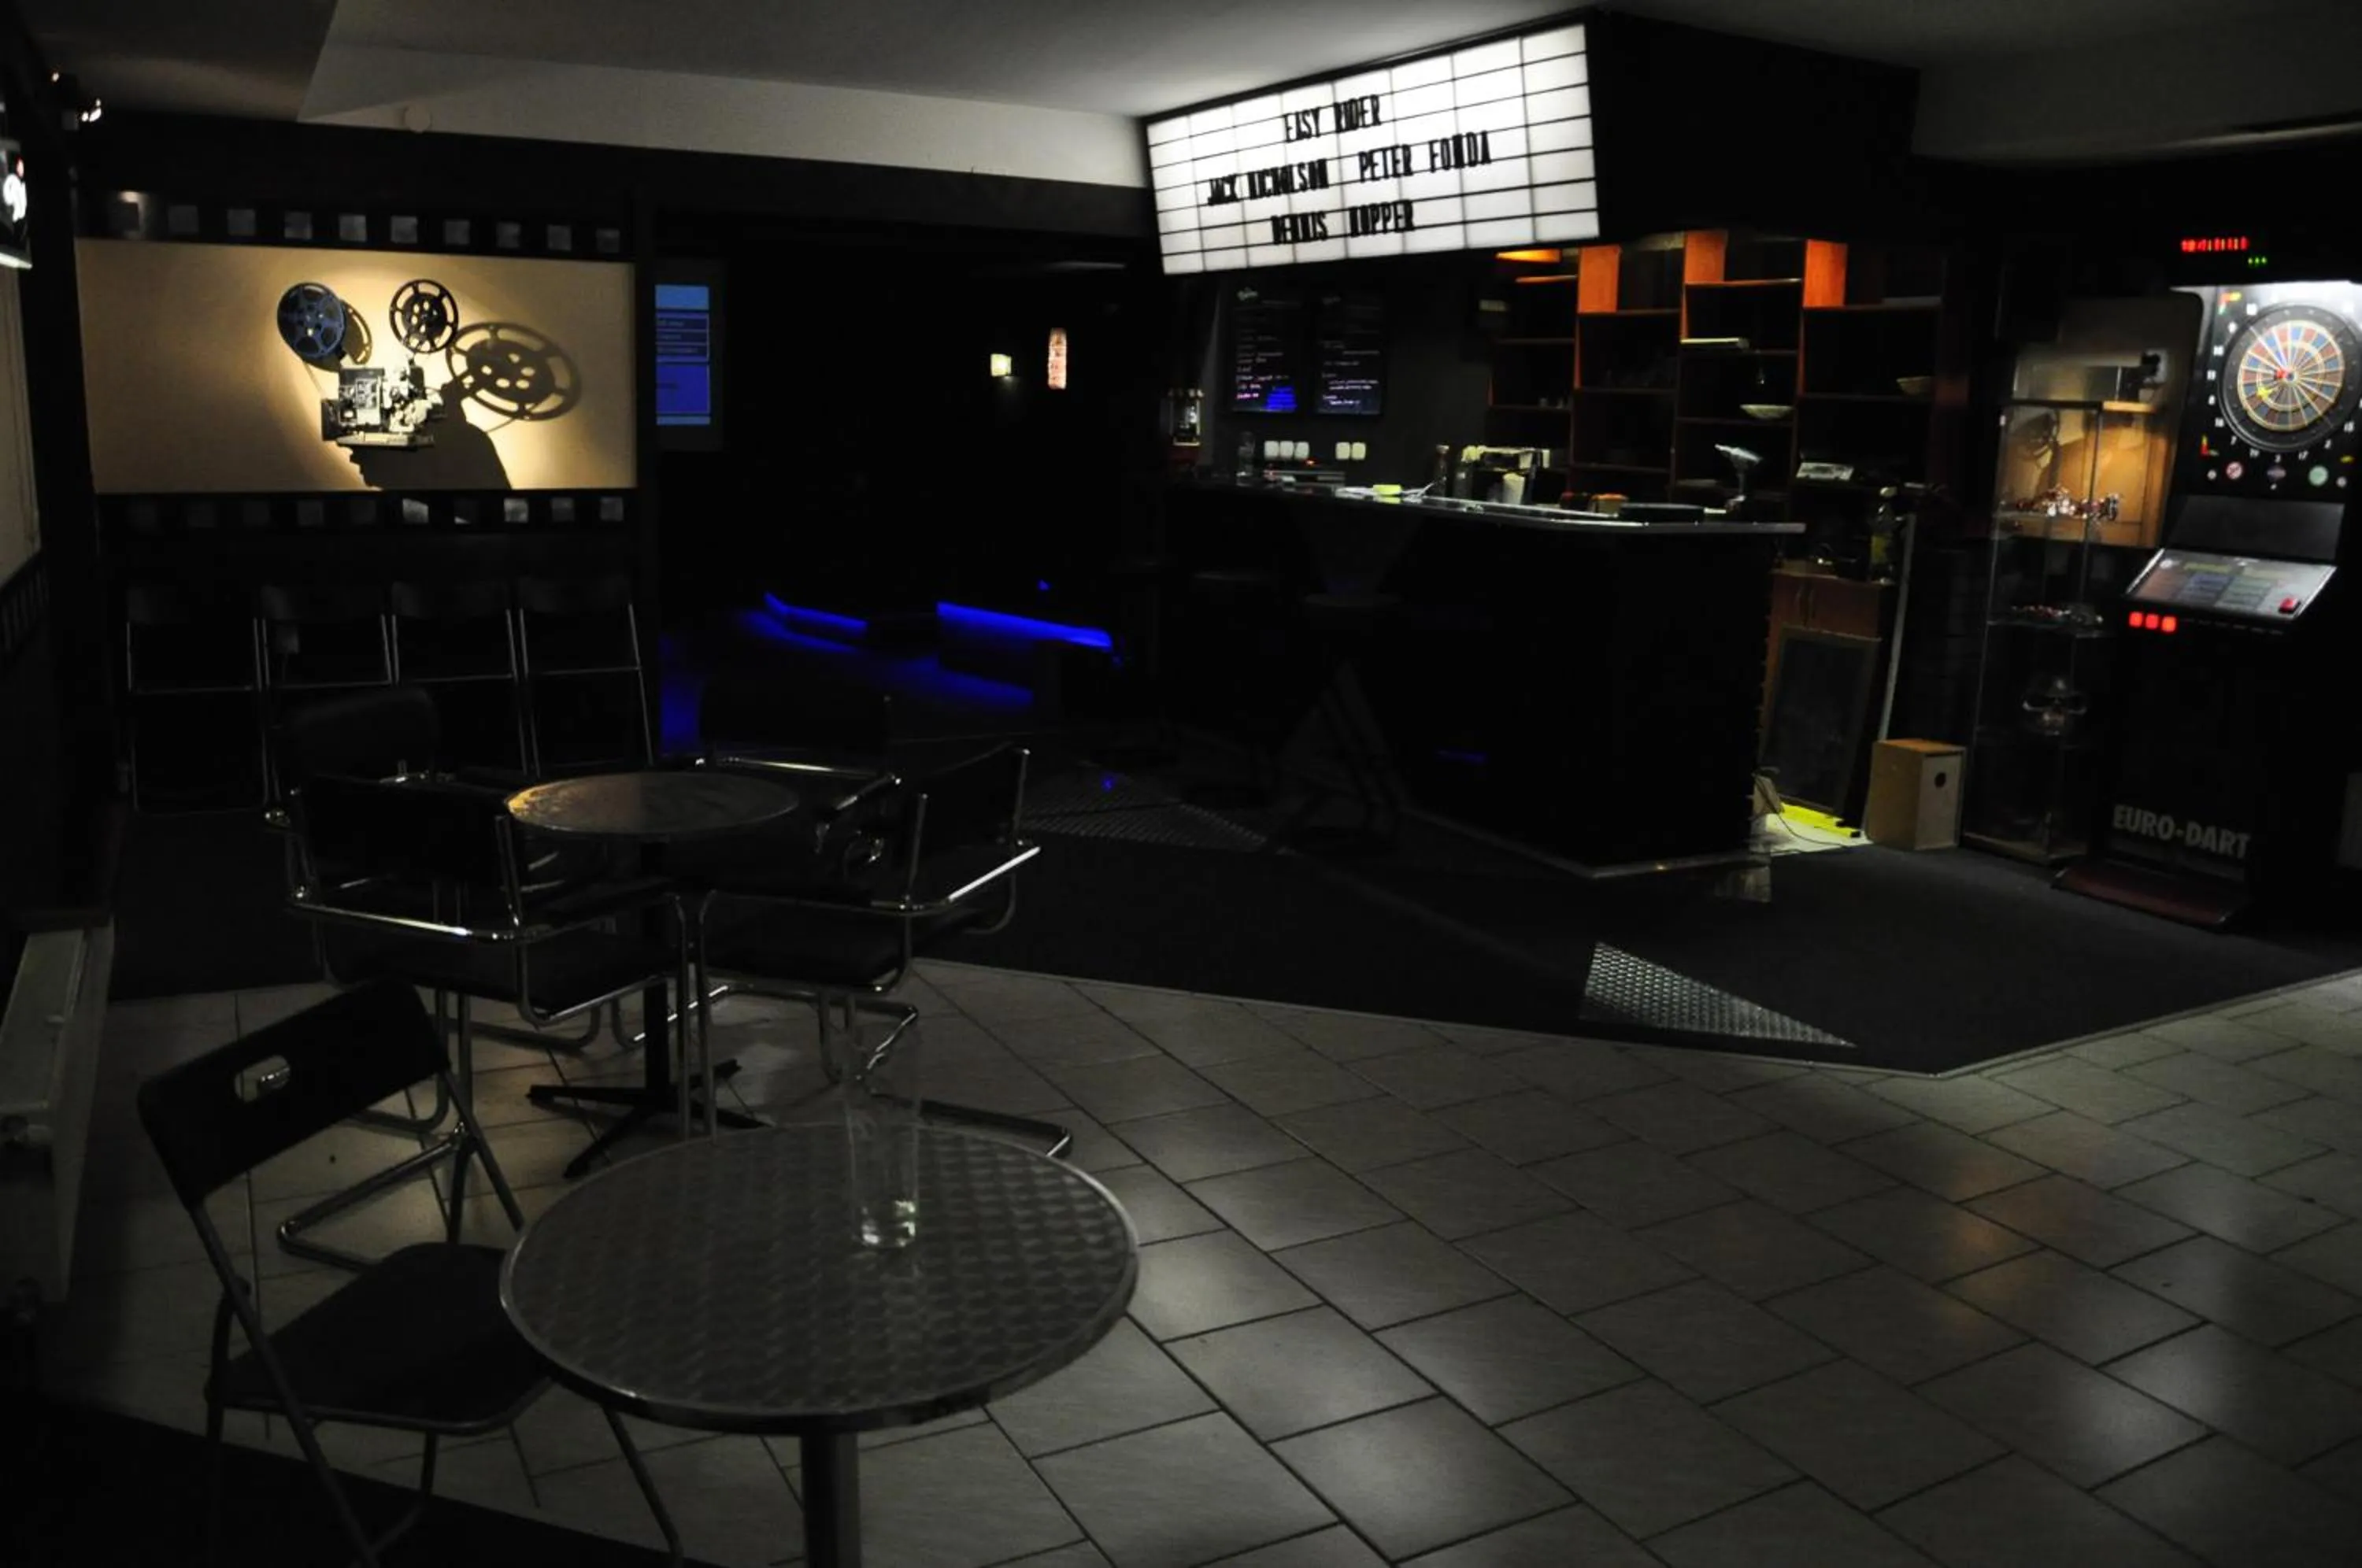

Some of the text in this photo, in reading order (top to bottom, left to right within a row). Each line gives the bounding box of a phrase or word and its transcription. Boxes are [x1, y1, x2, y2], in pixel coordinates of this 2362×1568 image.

[1283, 94, 1382, 142] EASY RIDER
[1208, 130, 1492, 206] JACK NICHOLSON PETER FONDA
[1271, 198, 1415, 245] DENNIS HOPPER
[2112, 803, 2252, 860] EURO-DART
